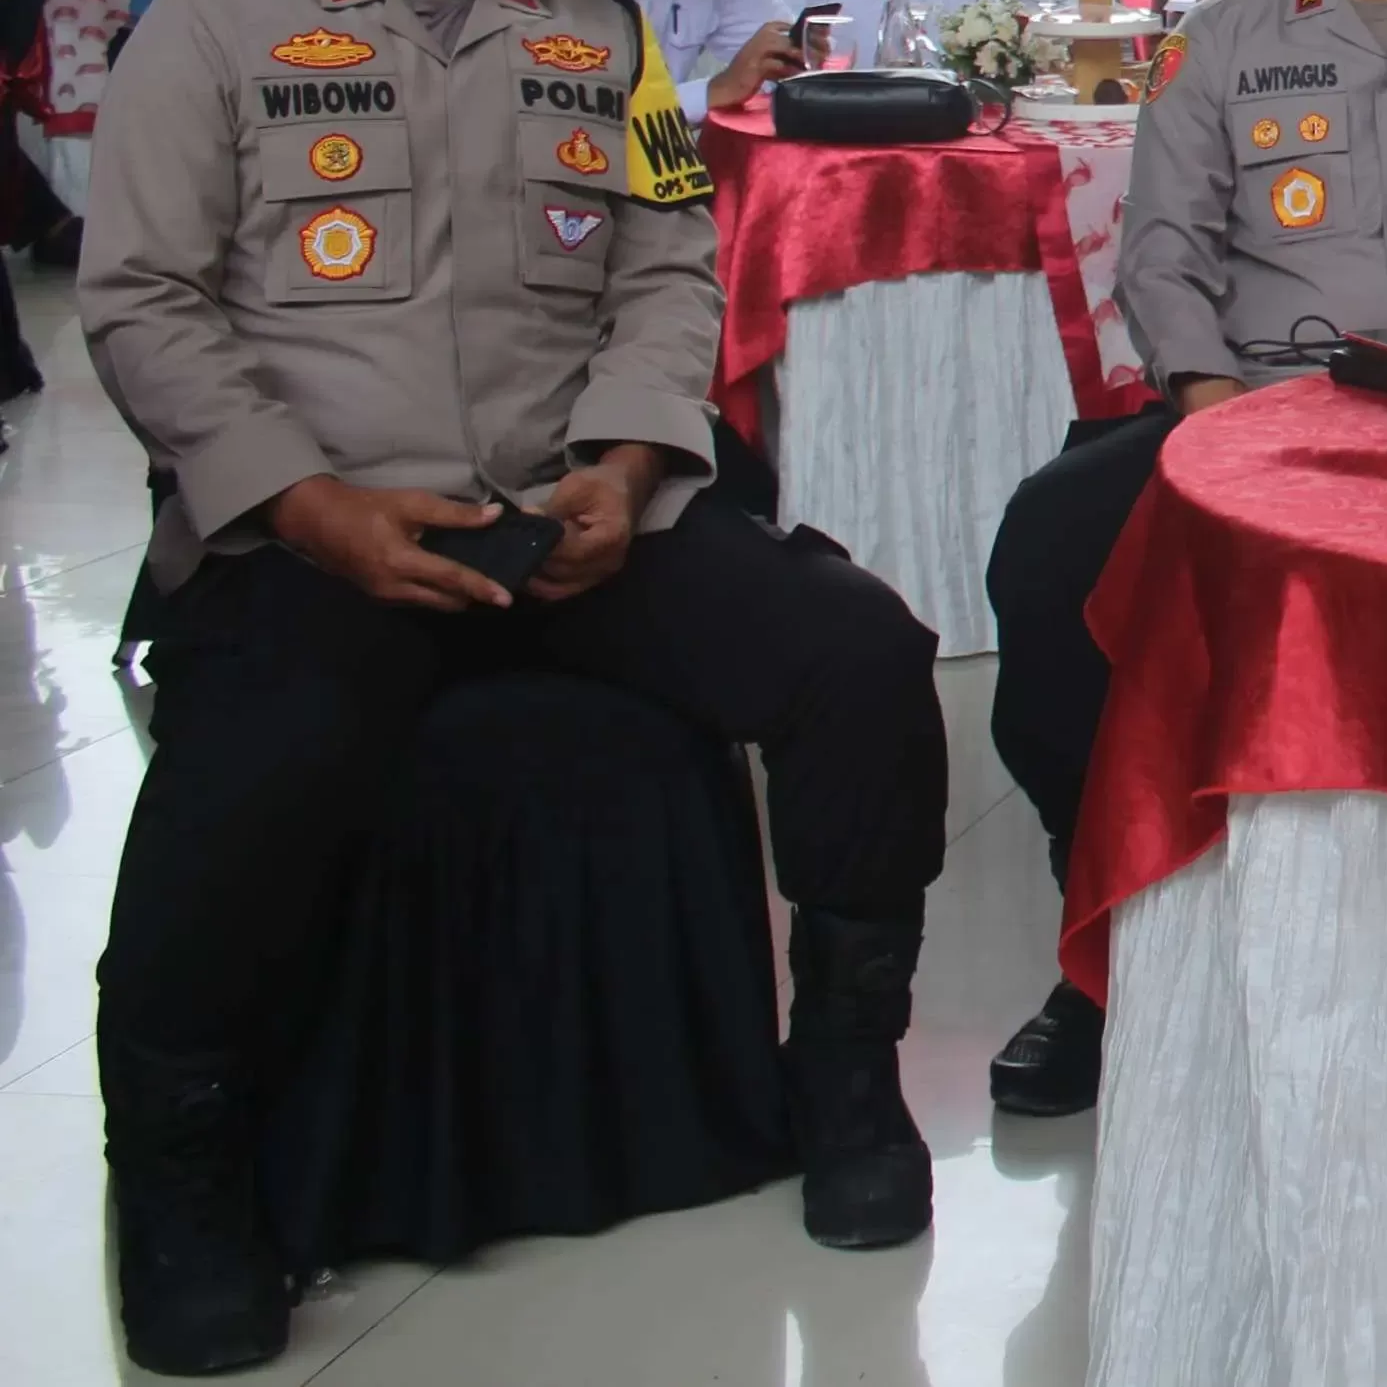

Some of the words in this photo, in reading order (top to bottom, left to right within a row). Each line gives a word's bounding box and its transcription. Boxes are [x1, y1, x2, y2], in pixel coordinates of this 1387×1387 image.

[1237, 63, 1338, 96] A.WIYAGUS
[262, 80, 396, 119] WIBOWO
[520, 78, 625, 122] POLRI
